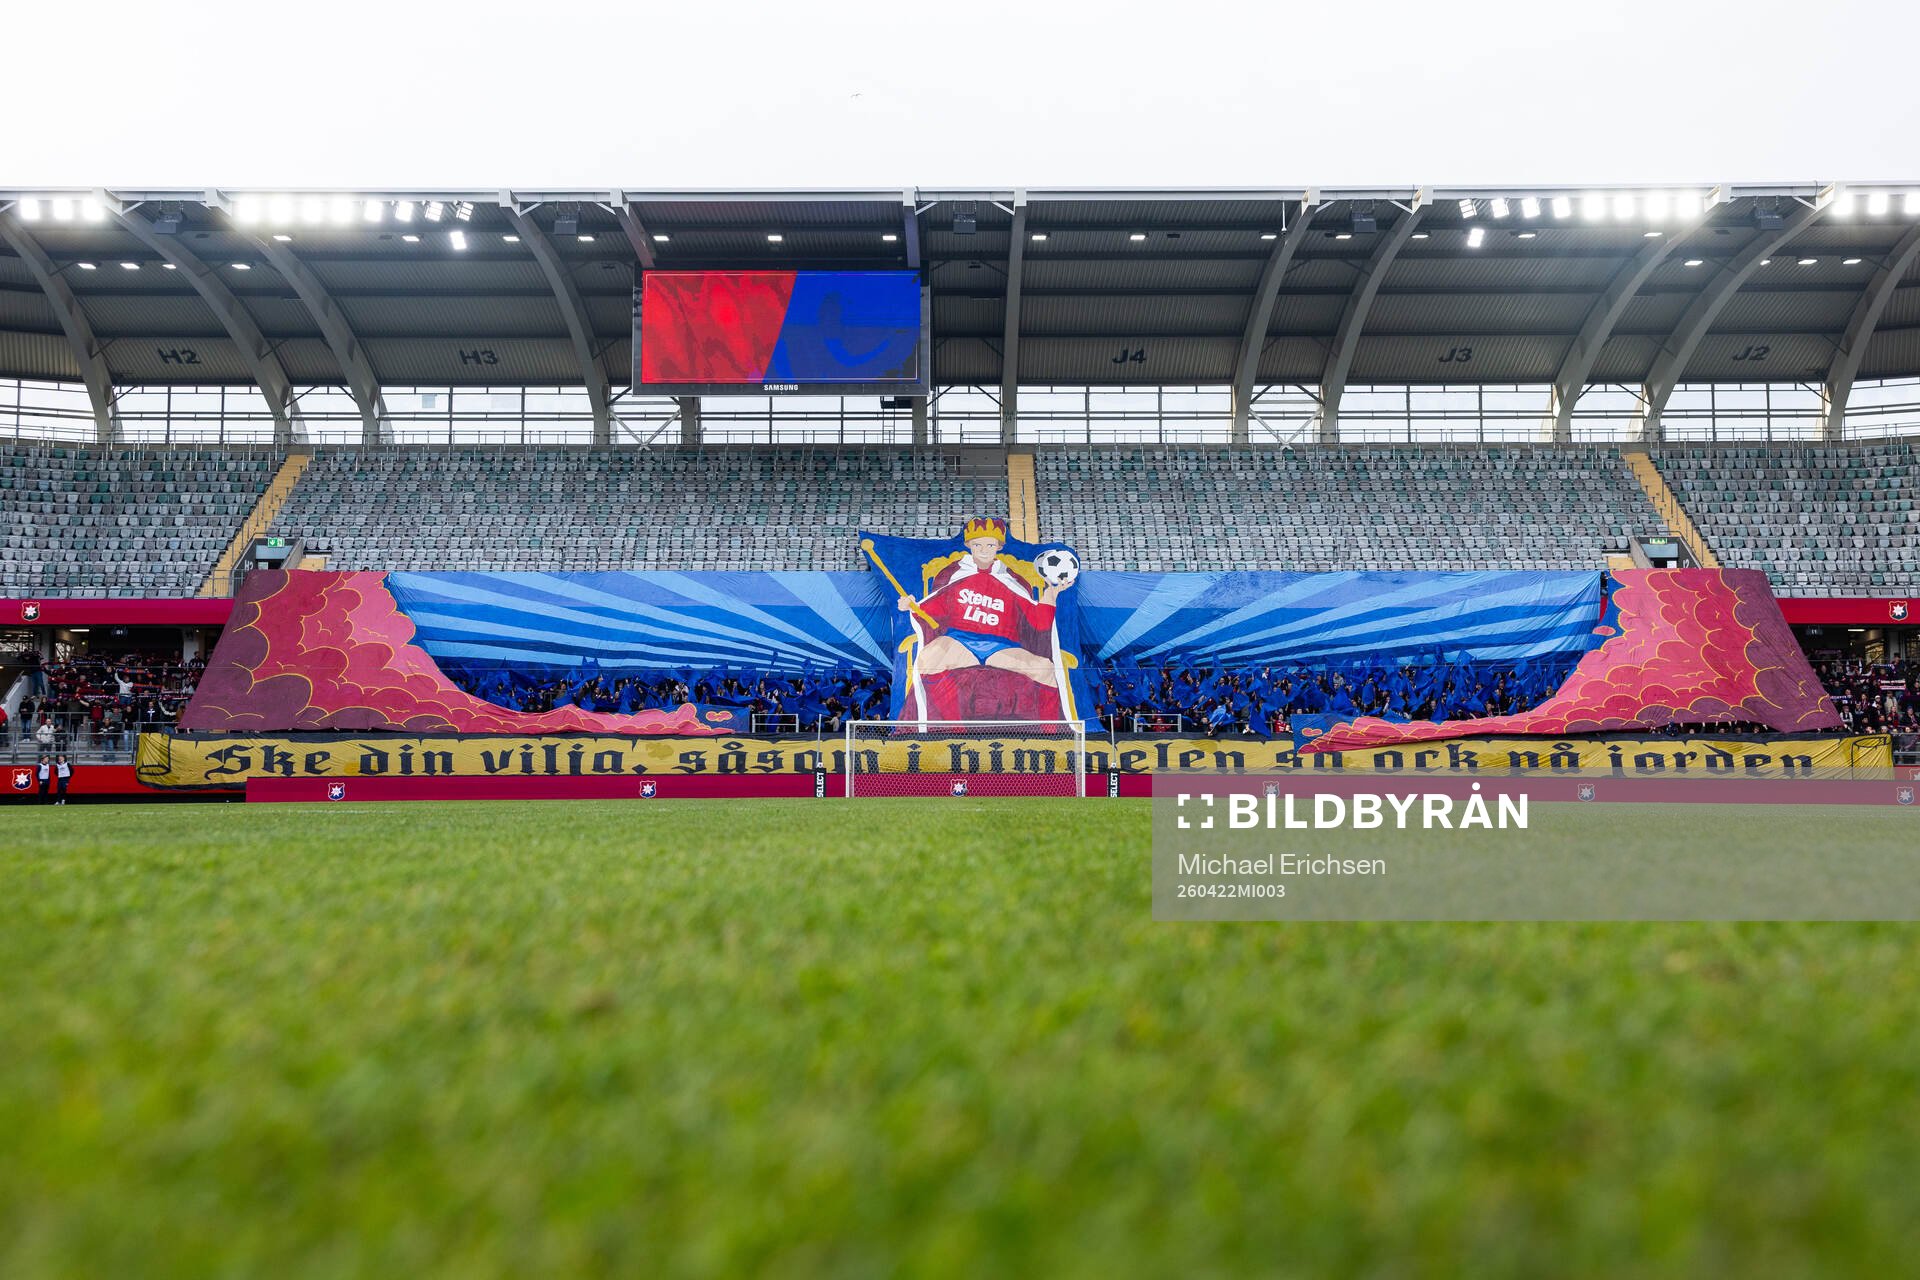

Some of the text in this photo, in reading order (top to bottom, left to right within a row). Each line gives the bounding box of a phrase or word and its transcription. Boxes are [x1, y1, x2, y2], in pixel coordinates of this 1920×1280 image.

[158, 349, 201, 364] H2
[459, 350, 498, 365] H3
[1112, 349, 1146, 363] J4
[1438, 348, 1472, 362] J3
[1732, 346, 1769, 360] J2
[957, 588, 1005, 613] Stena
[963, 605, 1000, 626] Line
[204, 744, 332, 780] Ske
[358, 743, 455, 775] din
[671, 741, 880, 774] såsom
[907, 743, 922, 773] i
[947, 741, 1247, 774] himmelen
[1373, 743, 1480, 774] ock
[1507, 742, 1583, 776] på
[1600, 743, 1816, 778] jorden
[816, 771, 825, 798] SELECT
[1110, 772, 1118, 798] SELECT
